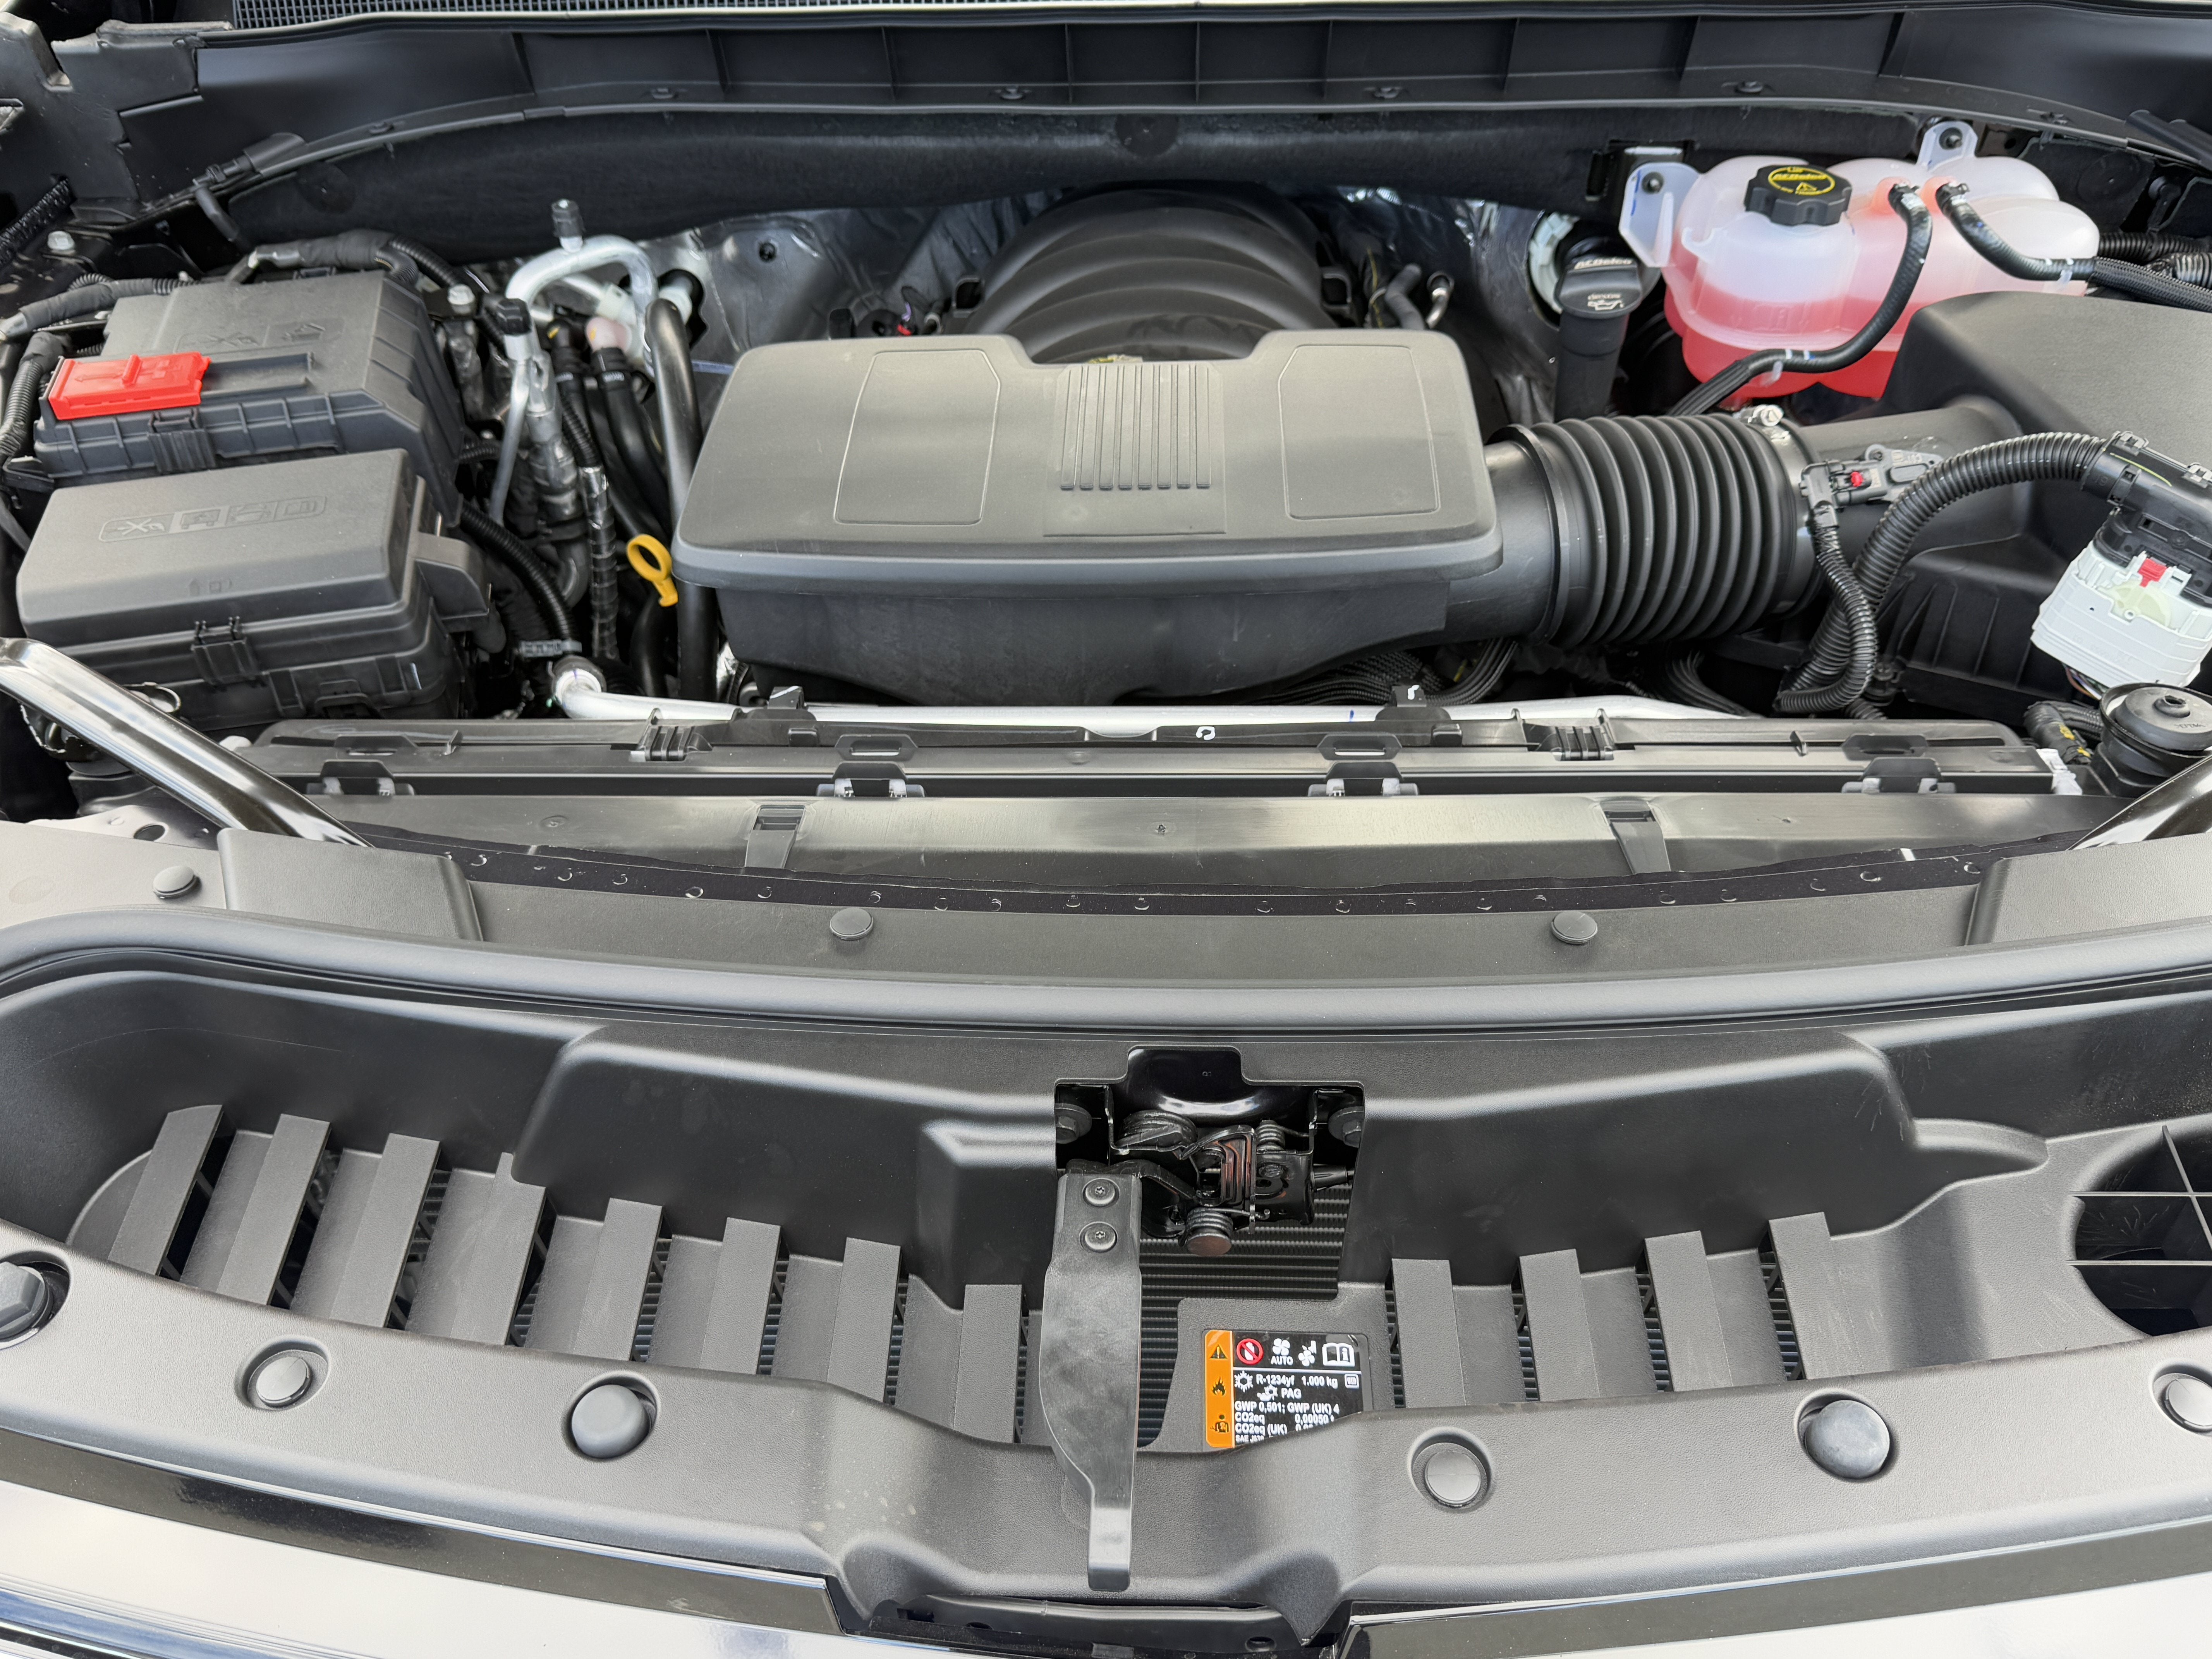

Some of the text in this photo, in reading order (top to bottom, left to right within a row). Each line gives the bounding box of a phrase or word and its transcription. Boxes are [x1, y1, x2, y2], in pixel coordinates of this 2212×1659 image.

[1271, 1355, 1293, 1365] AUTO
[1256, 1374, 1295, 1388] R-1234yf
[1326, 1376, 1338, 1389] kg
[1281, 1388, 1302, 1399] PAG
[1234, 1401, 1257, 1412] GWP
[1287, 1402, 1310, 1413] GWP
[1311, 1403, 1332, 1415] (UK)
[1333, 1403, 1340, 1415] 4
[1235, 1412, 1265, 1425] CO2eq
[1235, 1422, 1266, 1436] CO2eq
[1267, 1424, 1288, 1437] (UK)
